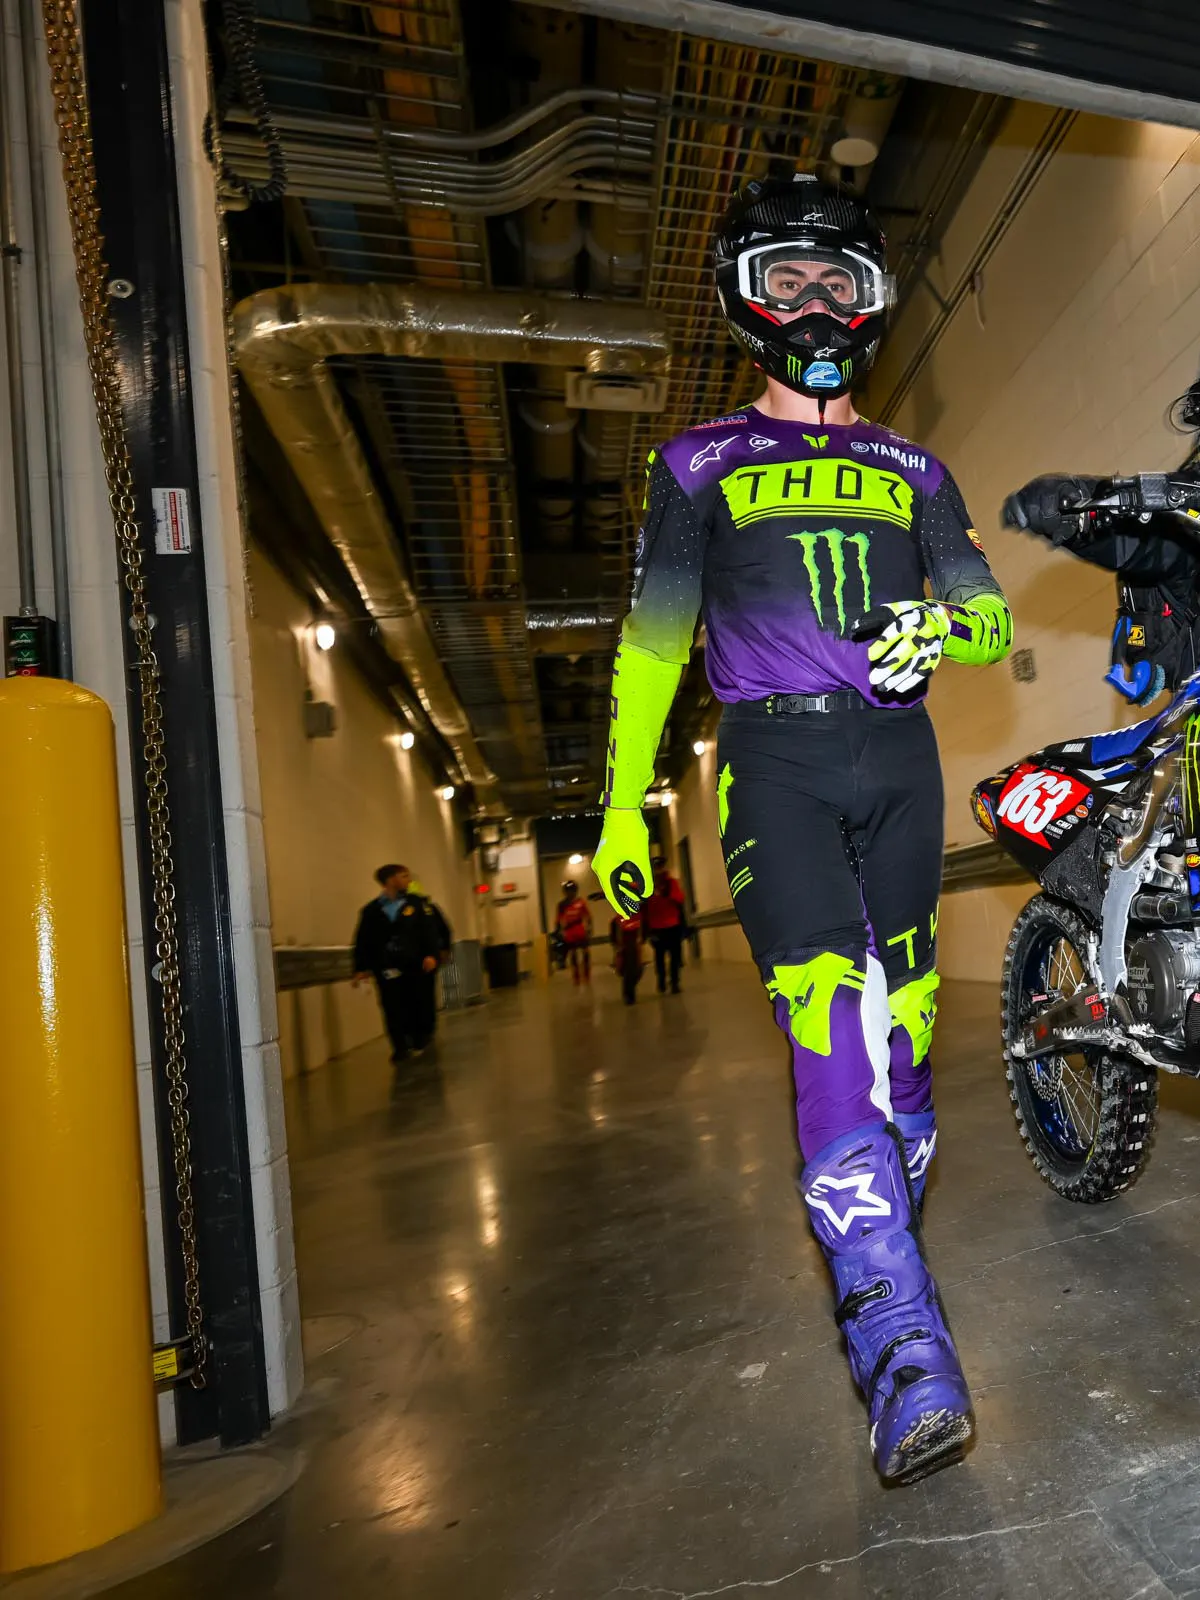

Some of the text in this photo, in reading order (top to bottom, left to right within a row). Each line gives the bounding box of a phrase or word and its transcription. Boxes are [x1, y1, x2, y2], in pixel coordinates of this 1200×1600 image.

[868, 442, 926, 472] YAMAHA
[737, 464, 904, 512] THOR
[996, 772, 1072, 834] 163
